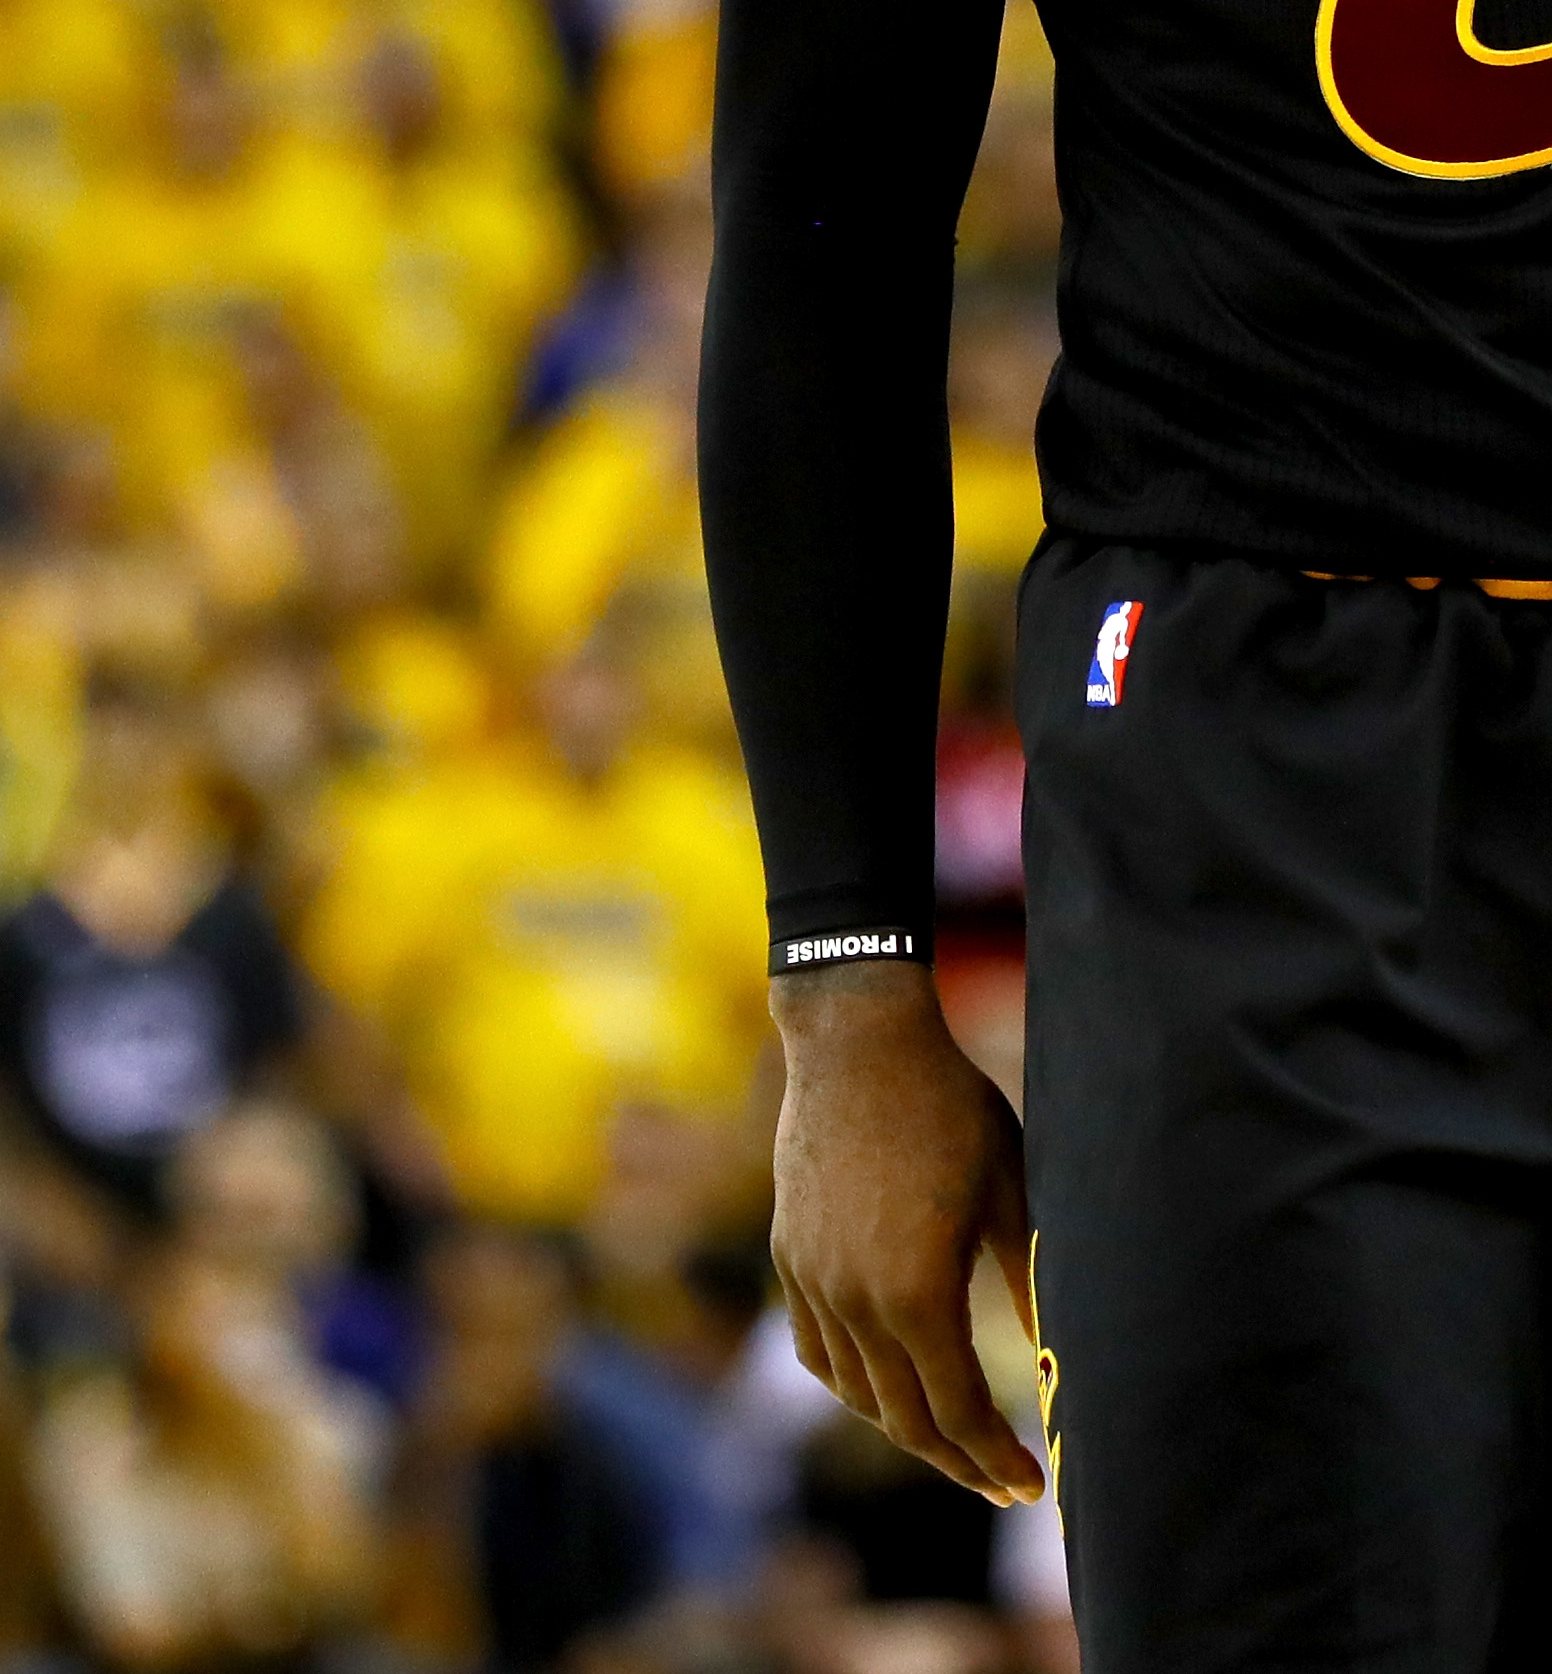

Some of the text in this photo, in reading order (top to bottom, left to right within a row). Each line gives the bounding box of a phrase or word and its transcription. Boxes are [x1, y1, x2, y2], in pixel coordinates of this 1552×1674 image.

[1086, 683, 1111, 702] NBA
[786, 934, 913, 964] I PROMISE
